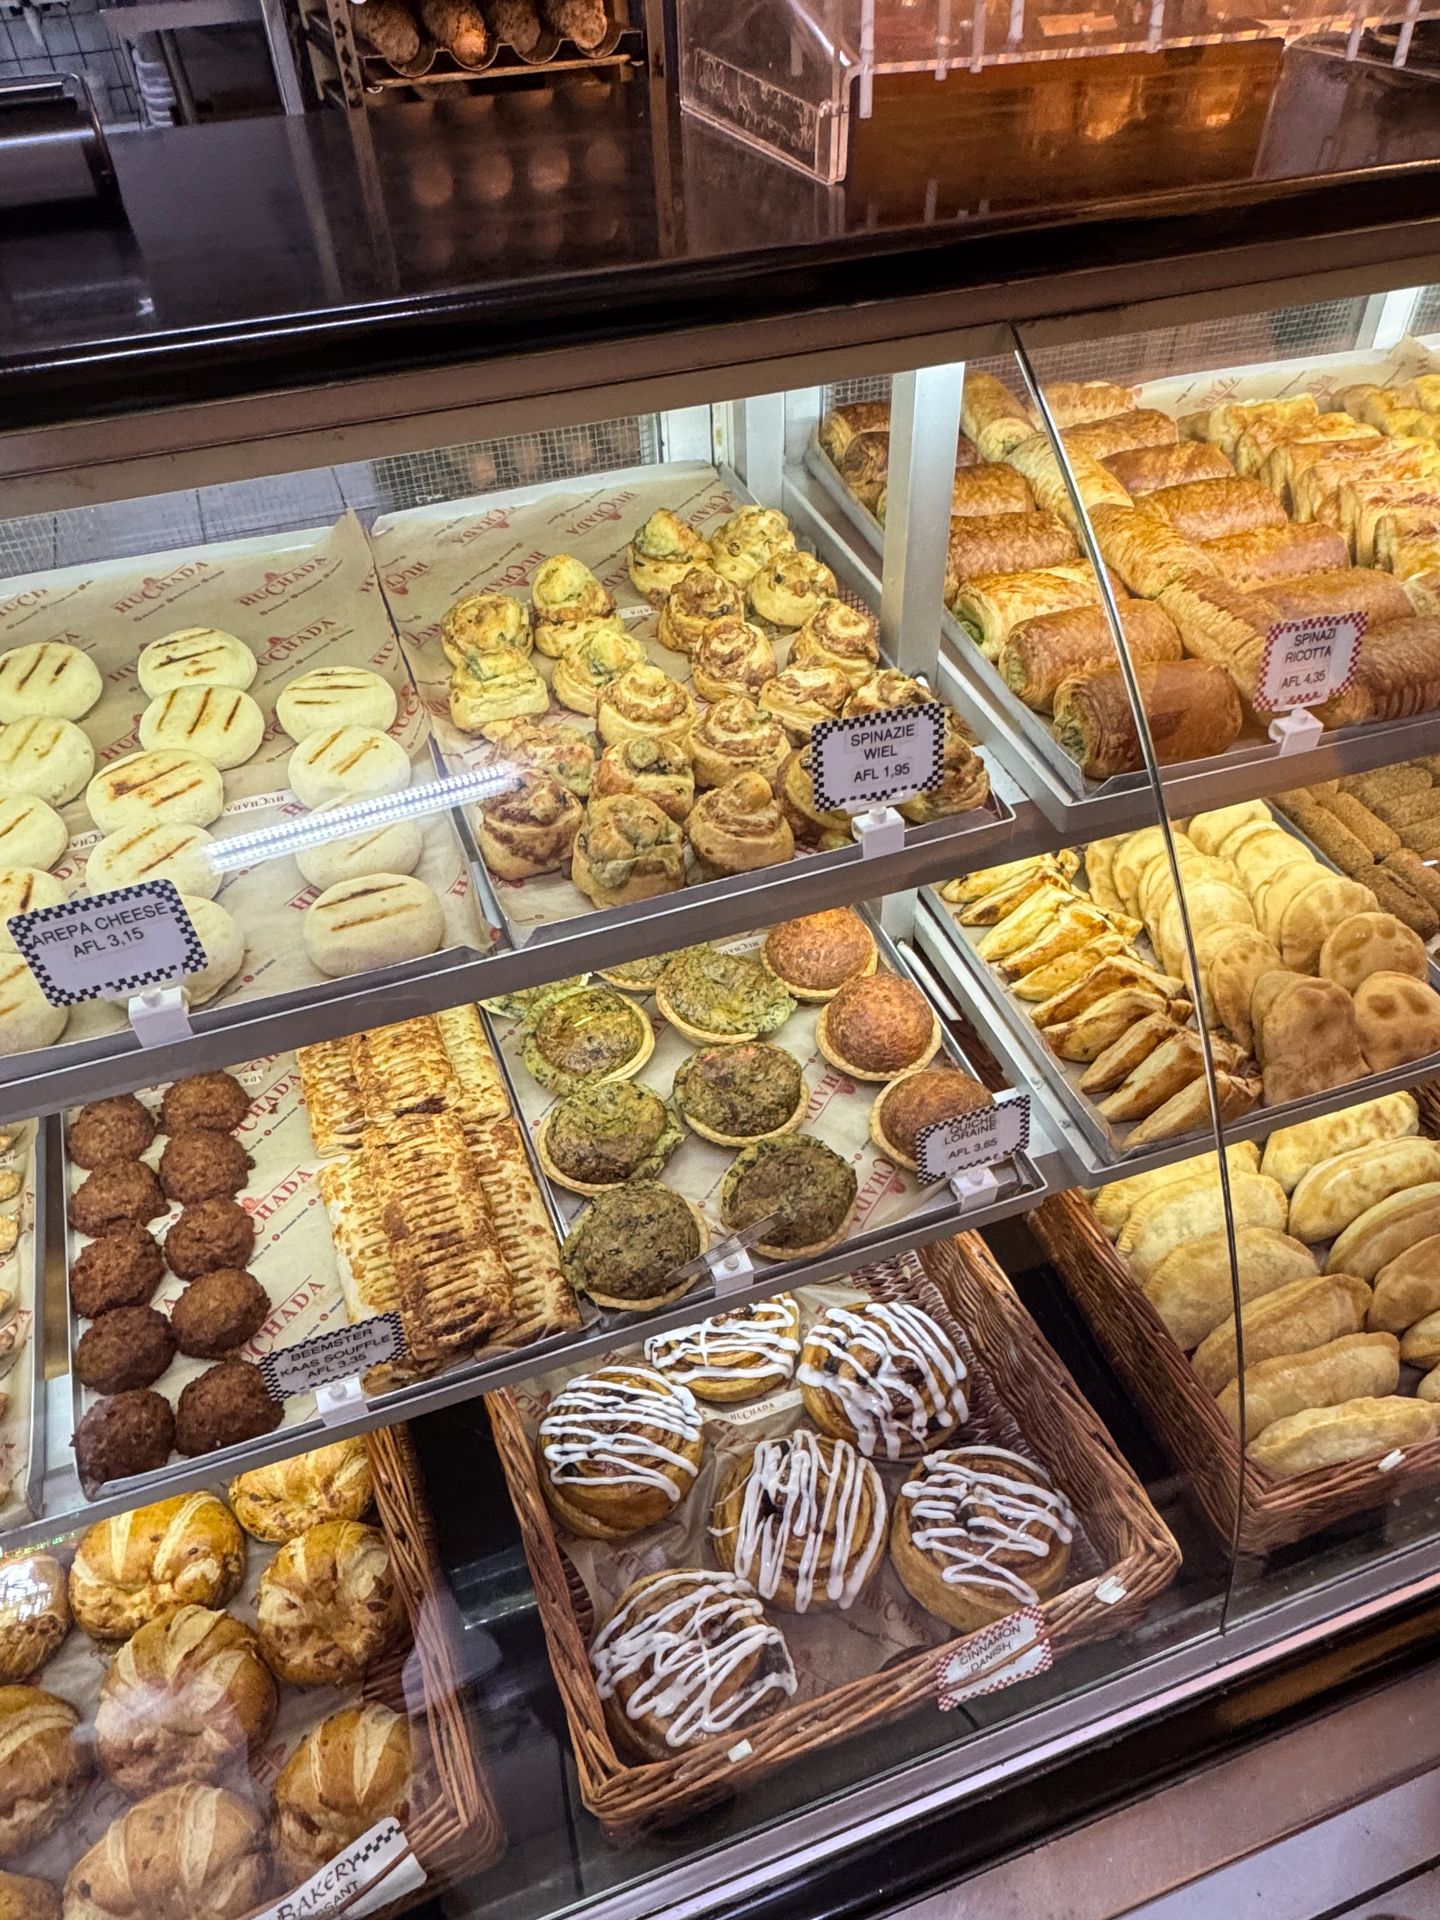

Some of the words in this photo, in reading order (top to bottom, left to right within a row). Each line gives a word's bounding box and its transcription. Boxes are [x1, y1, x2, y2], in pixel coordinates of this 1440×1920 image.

[114, 560, 209, 614] HUCHADA
[239, 554, 327, 608] HUCHADA
[257, 618, 337, 668] UCHADA
[1293, 628, 1337, 647] SPINAZI
[1285, 645, 1332, 662] RICOTTA
[1281, 676, 1301, 689] AFL
[850, 724, 915, 747] SPINAZIE
[863, 745, 898, 761] WIEL
[853, 768, 879, 783] AFL
[884, 763, 911, 779] 1,95
[32, 922, 93, 949] AREPA
[95, 901, 168, 931] CHEESE
[72, 942, 107, 959] AFL
[110, 927, 145, 949] 3,15
[944, 1122, 998, 1146] LORAINE
[949, 1113, 997, 1135] QUICHE
[948, 1147, 971, 1160] AFL
[280, 1359, 320, 1378] KAAS
[323, 1334, 391, 1361] SOUFFLE
[291, 1328, 373, 1362] BEEMSTER
[308, 1366, 335, 1379] AFL
[959, 1625, 1021, 1666] CINNAMON
[970, 1641, 1013, 1673] DANISH
[276, 1856, 360, 1920] BAKERY
